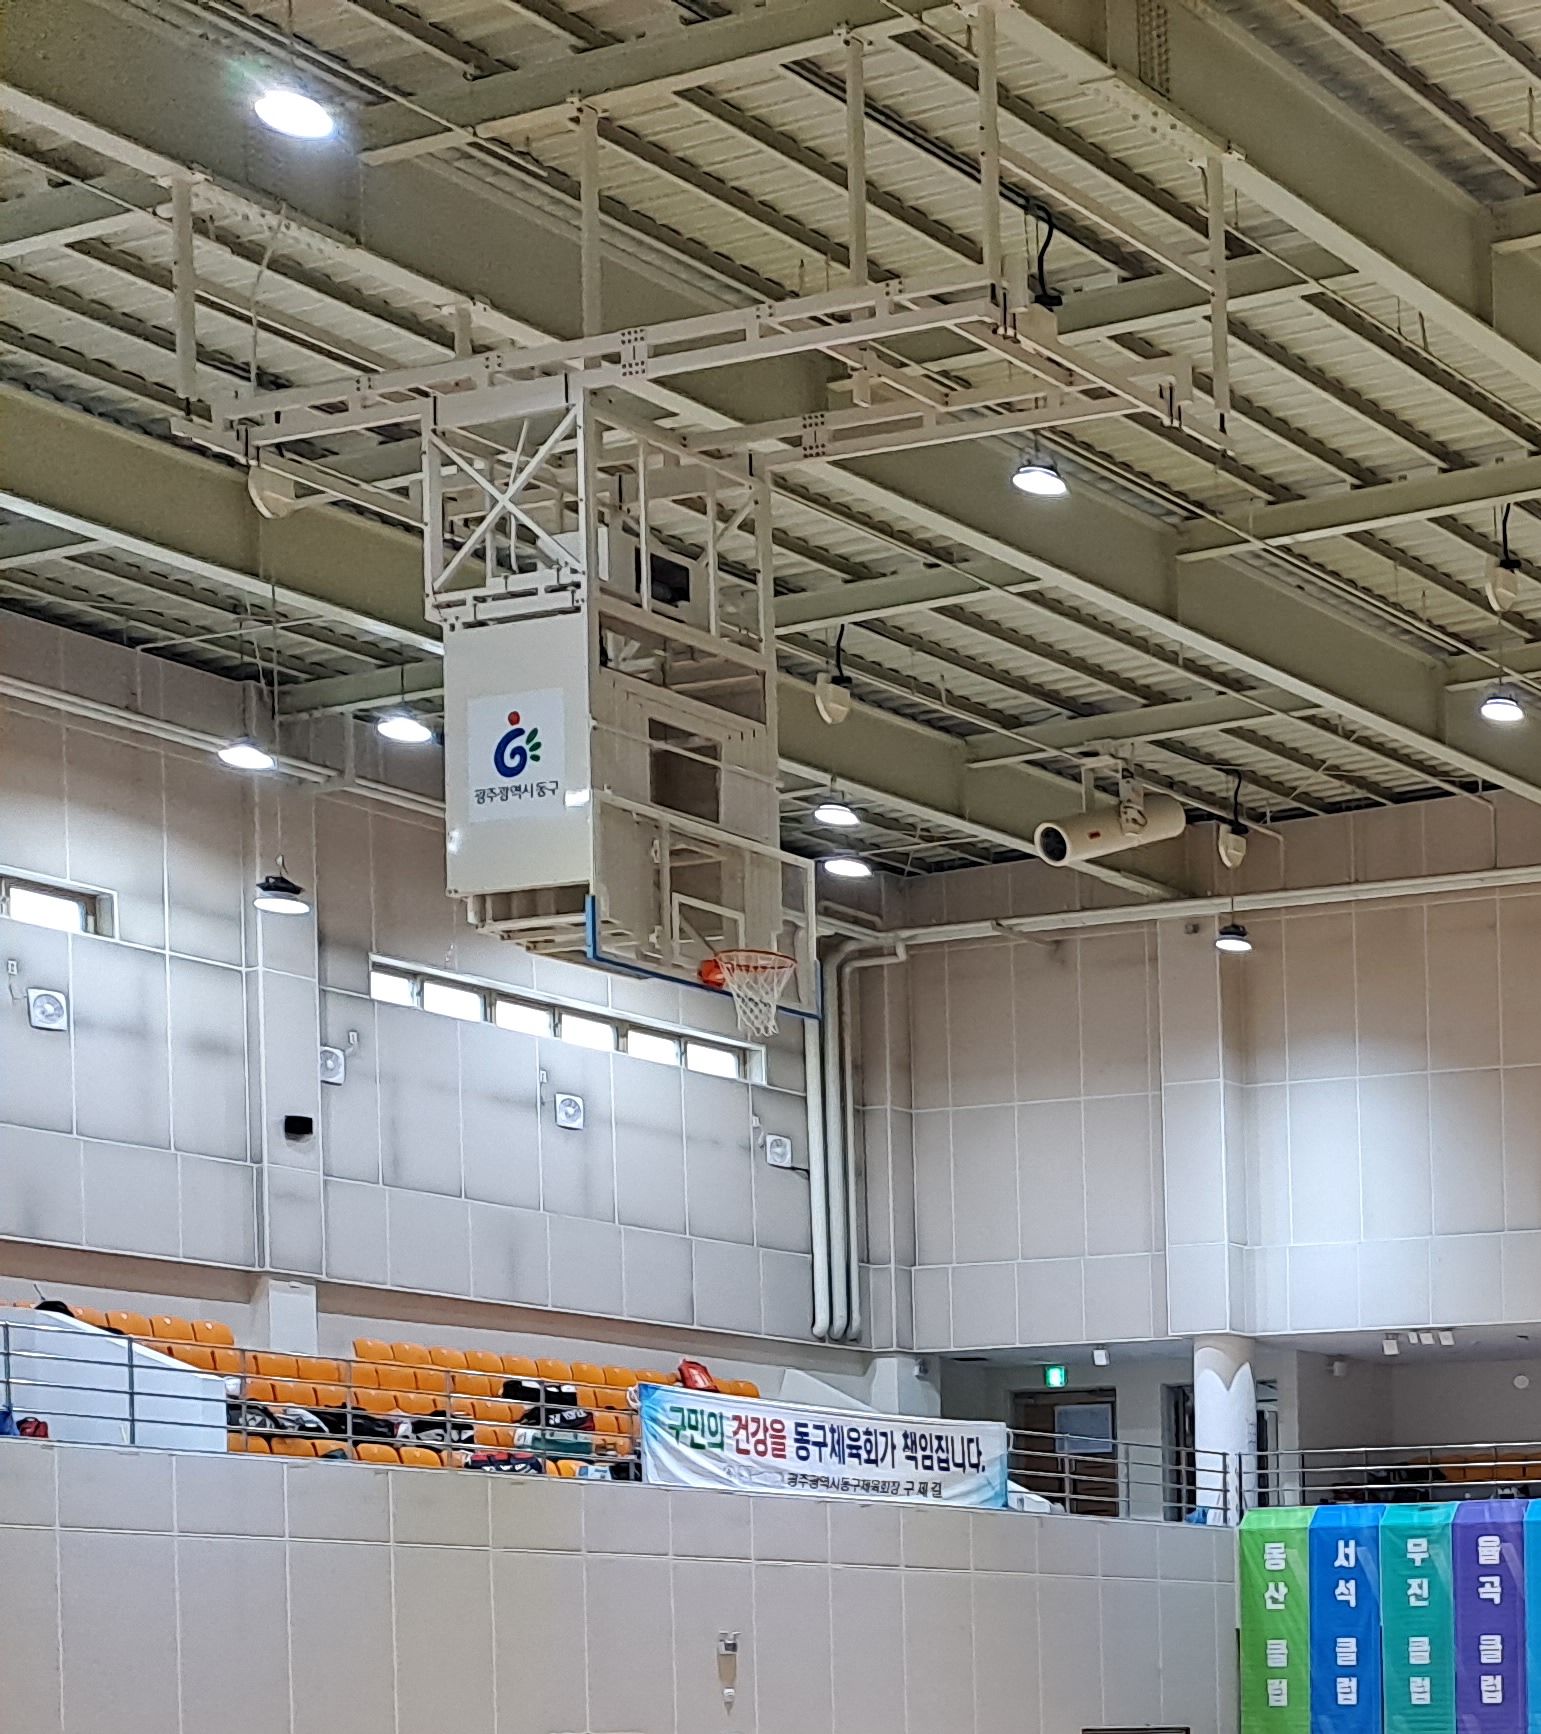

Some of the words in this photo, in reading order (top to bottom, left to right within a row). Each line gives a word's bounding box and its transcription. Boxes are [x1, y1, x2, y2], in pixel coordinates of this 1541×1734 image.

[474, 783, 533, 804] 광주광역시
[536, 780, 559, 798] 동구
[667, 1405, 725, 1452] 구민의
[731, 1413, 787, 1460] 건강을
[793, 1421, 896, 1469] 동구체육회가
[901, 1430, 986, 1474] 책임집니다.
[1263, 1542, 1289, 1610] 동산
[1333, 1539, 1357, 1608] 서석
[1406, 1537, 1430, 1607] 무진
[1477, 1534, 1502, 1605] 율곡
[1266, 1639, 1288, 1707] 클럽
[1335, 1637, 1358, 1705] 클럽
[1408, 1636, 1431, 1705] 클럽
[1479, 1634, 1503, 1704] 클럽
